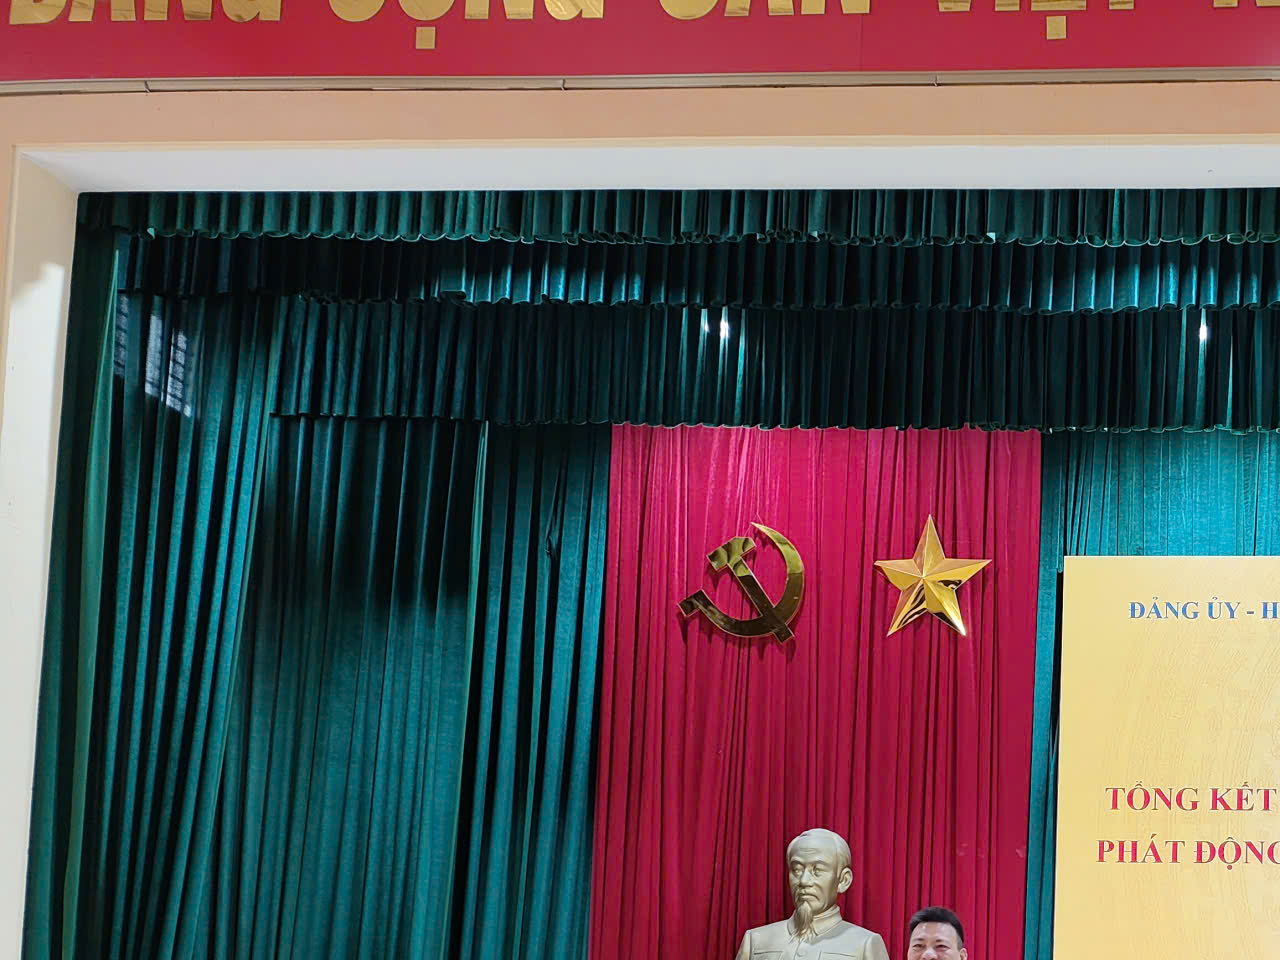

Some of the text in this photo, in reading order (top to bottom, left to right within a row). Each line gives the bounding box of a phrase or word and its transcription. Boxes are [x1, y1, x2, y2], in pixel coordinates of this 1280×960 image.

[1129, 596, 1199, 620] ĐẢNG
[1207, 596, 1241, 620] ỦY
[1105, 781, 1200, 811] TỔNG
[1210, 782, 1277, 811] KẾT
[1096, 834, 1186, 864] PHÁT
